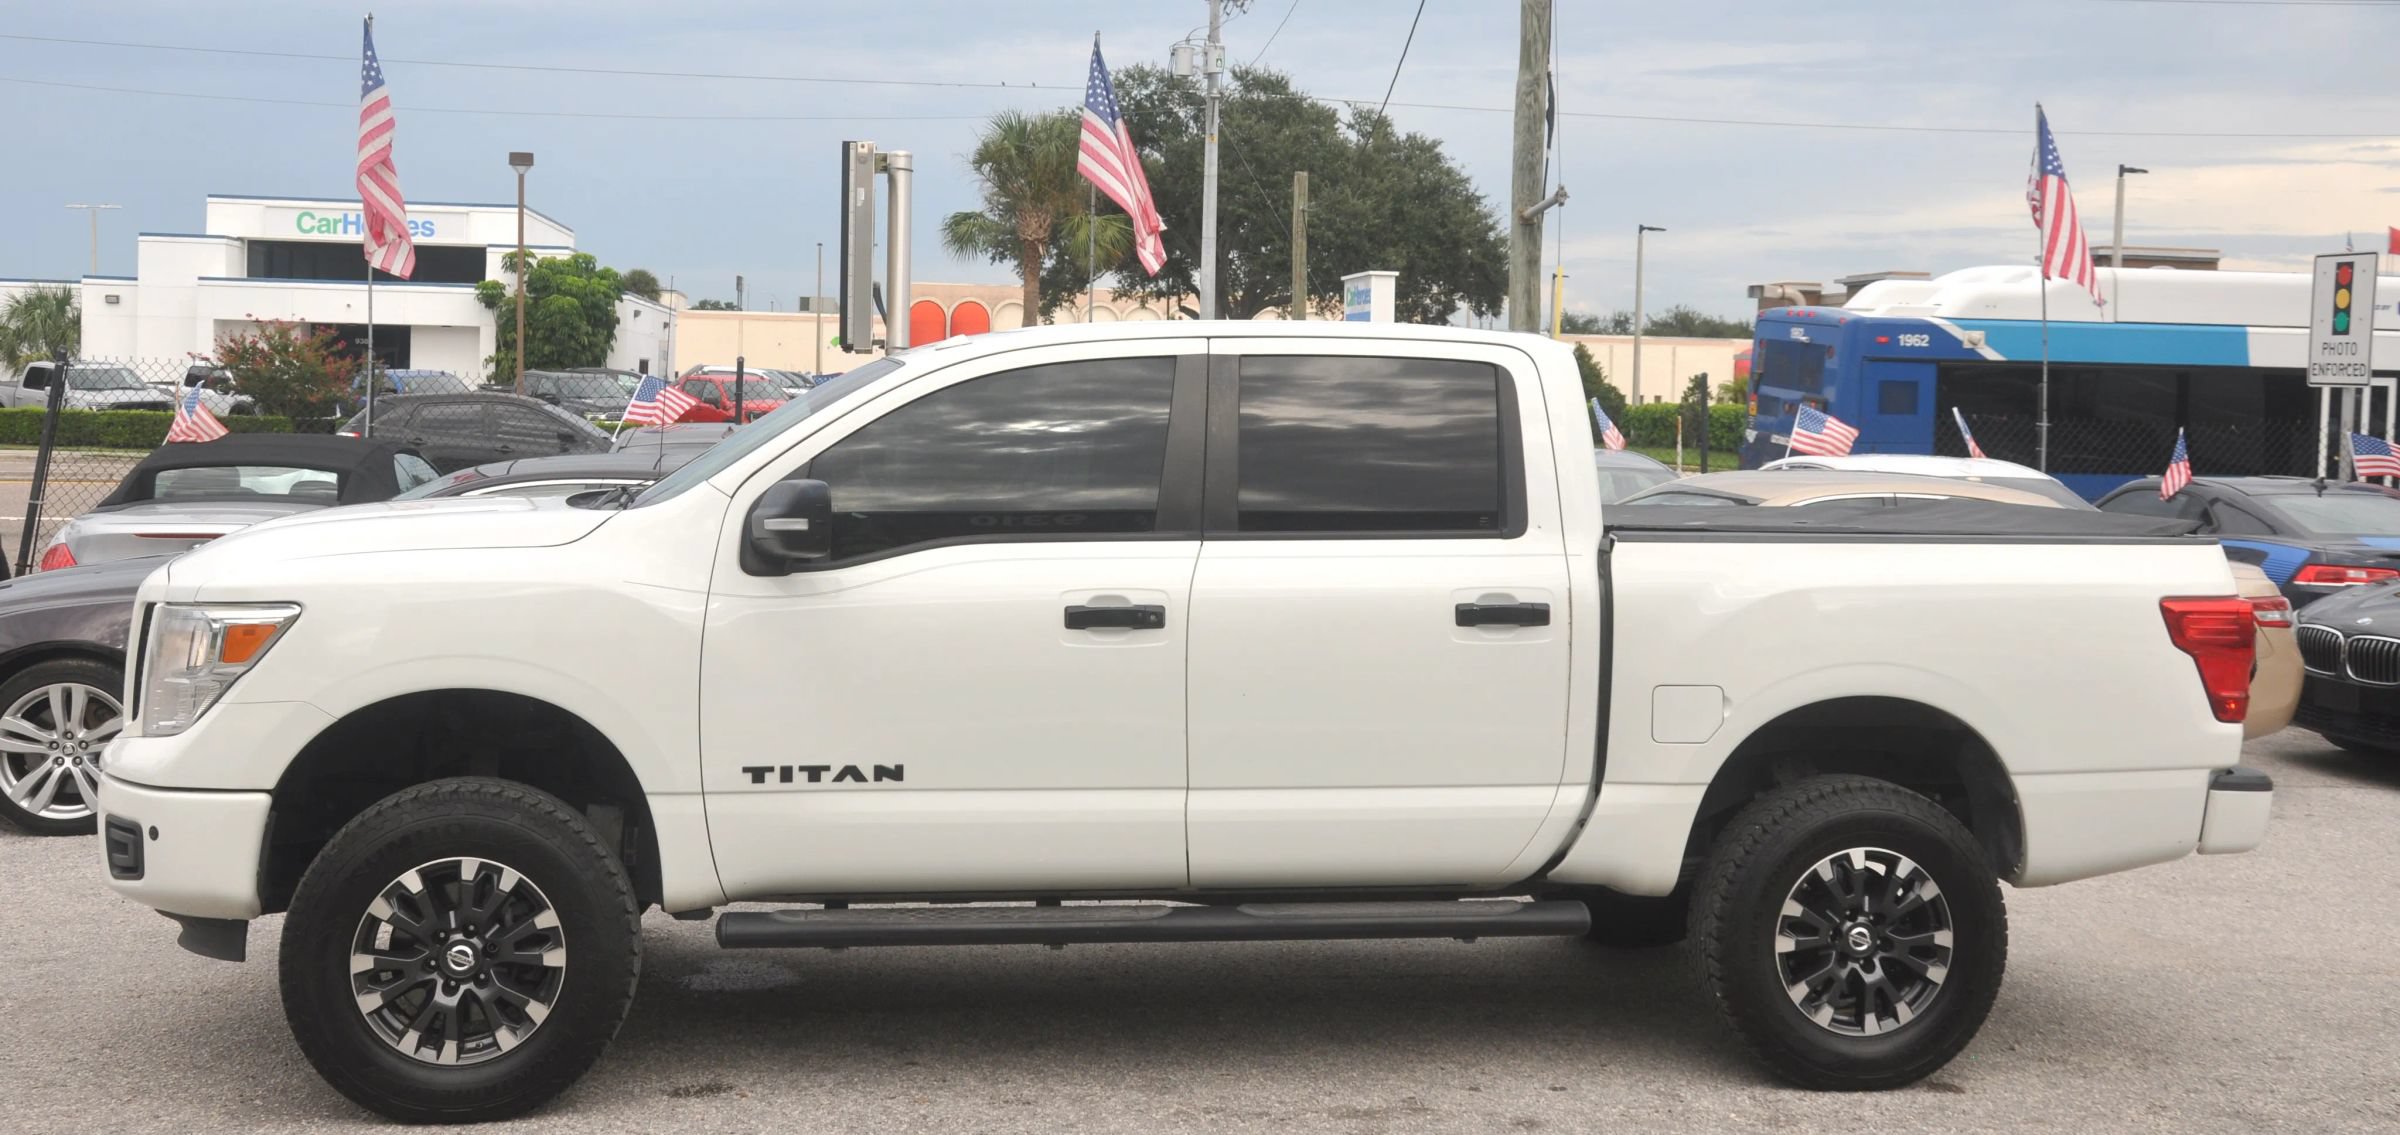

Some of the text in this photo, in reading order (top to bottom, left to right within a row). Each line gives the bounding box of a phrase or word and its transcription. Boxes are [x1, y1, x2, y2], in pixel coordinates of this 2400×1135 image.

[296, 211, 435, 237] CarHes
[1898, 334, 1930, 347] 1962
[2321, 342, 2358, 355] PHOTO
[2311, 362, 2366, 377] ENFORCED
[742, 764, 904, 784] TITAN
